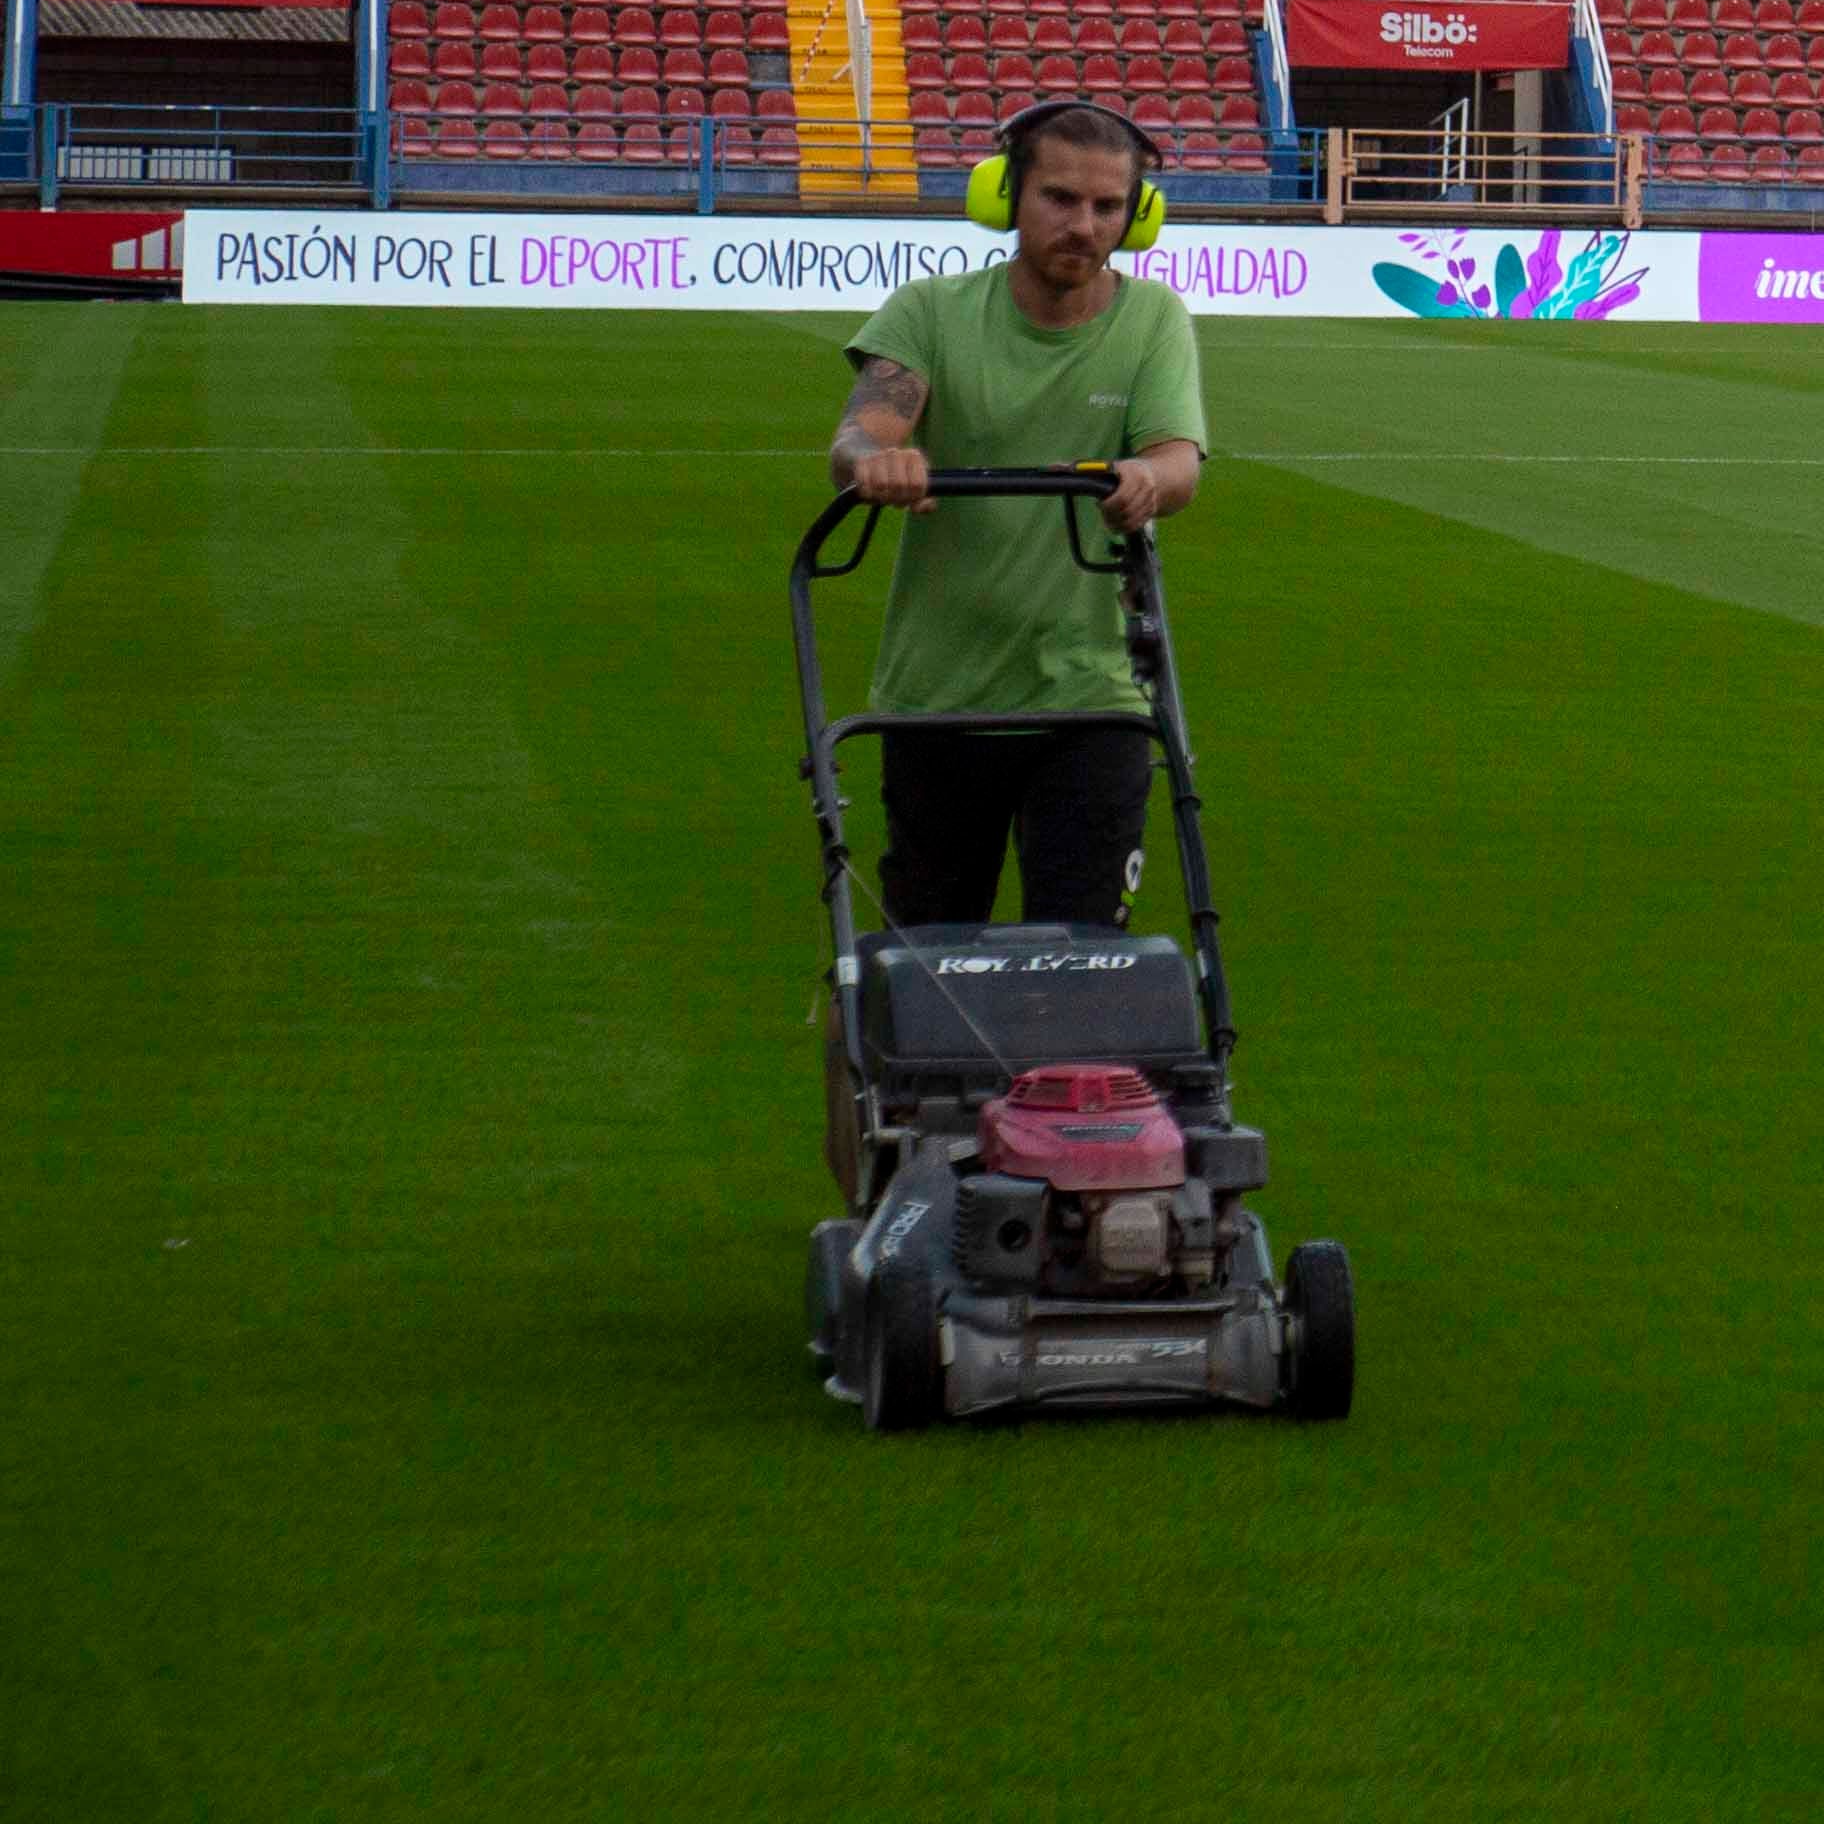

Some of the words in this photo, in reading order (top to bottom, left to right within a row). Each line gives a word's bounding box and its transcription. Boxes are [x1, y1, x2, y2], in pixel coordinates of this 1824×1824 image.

[1403, 43, 1454, 58] Telecom
[216, 224, 358, 286] PASIÓN
[373, 234, 452, 288] POR
[469, 233, 506, 287] EL
[519, 235, 698, 291] DEPORTE,
